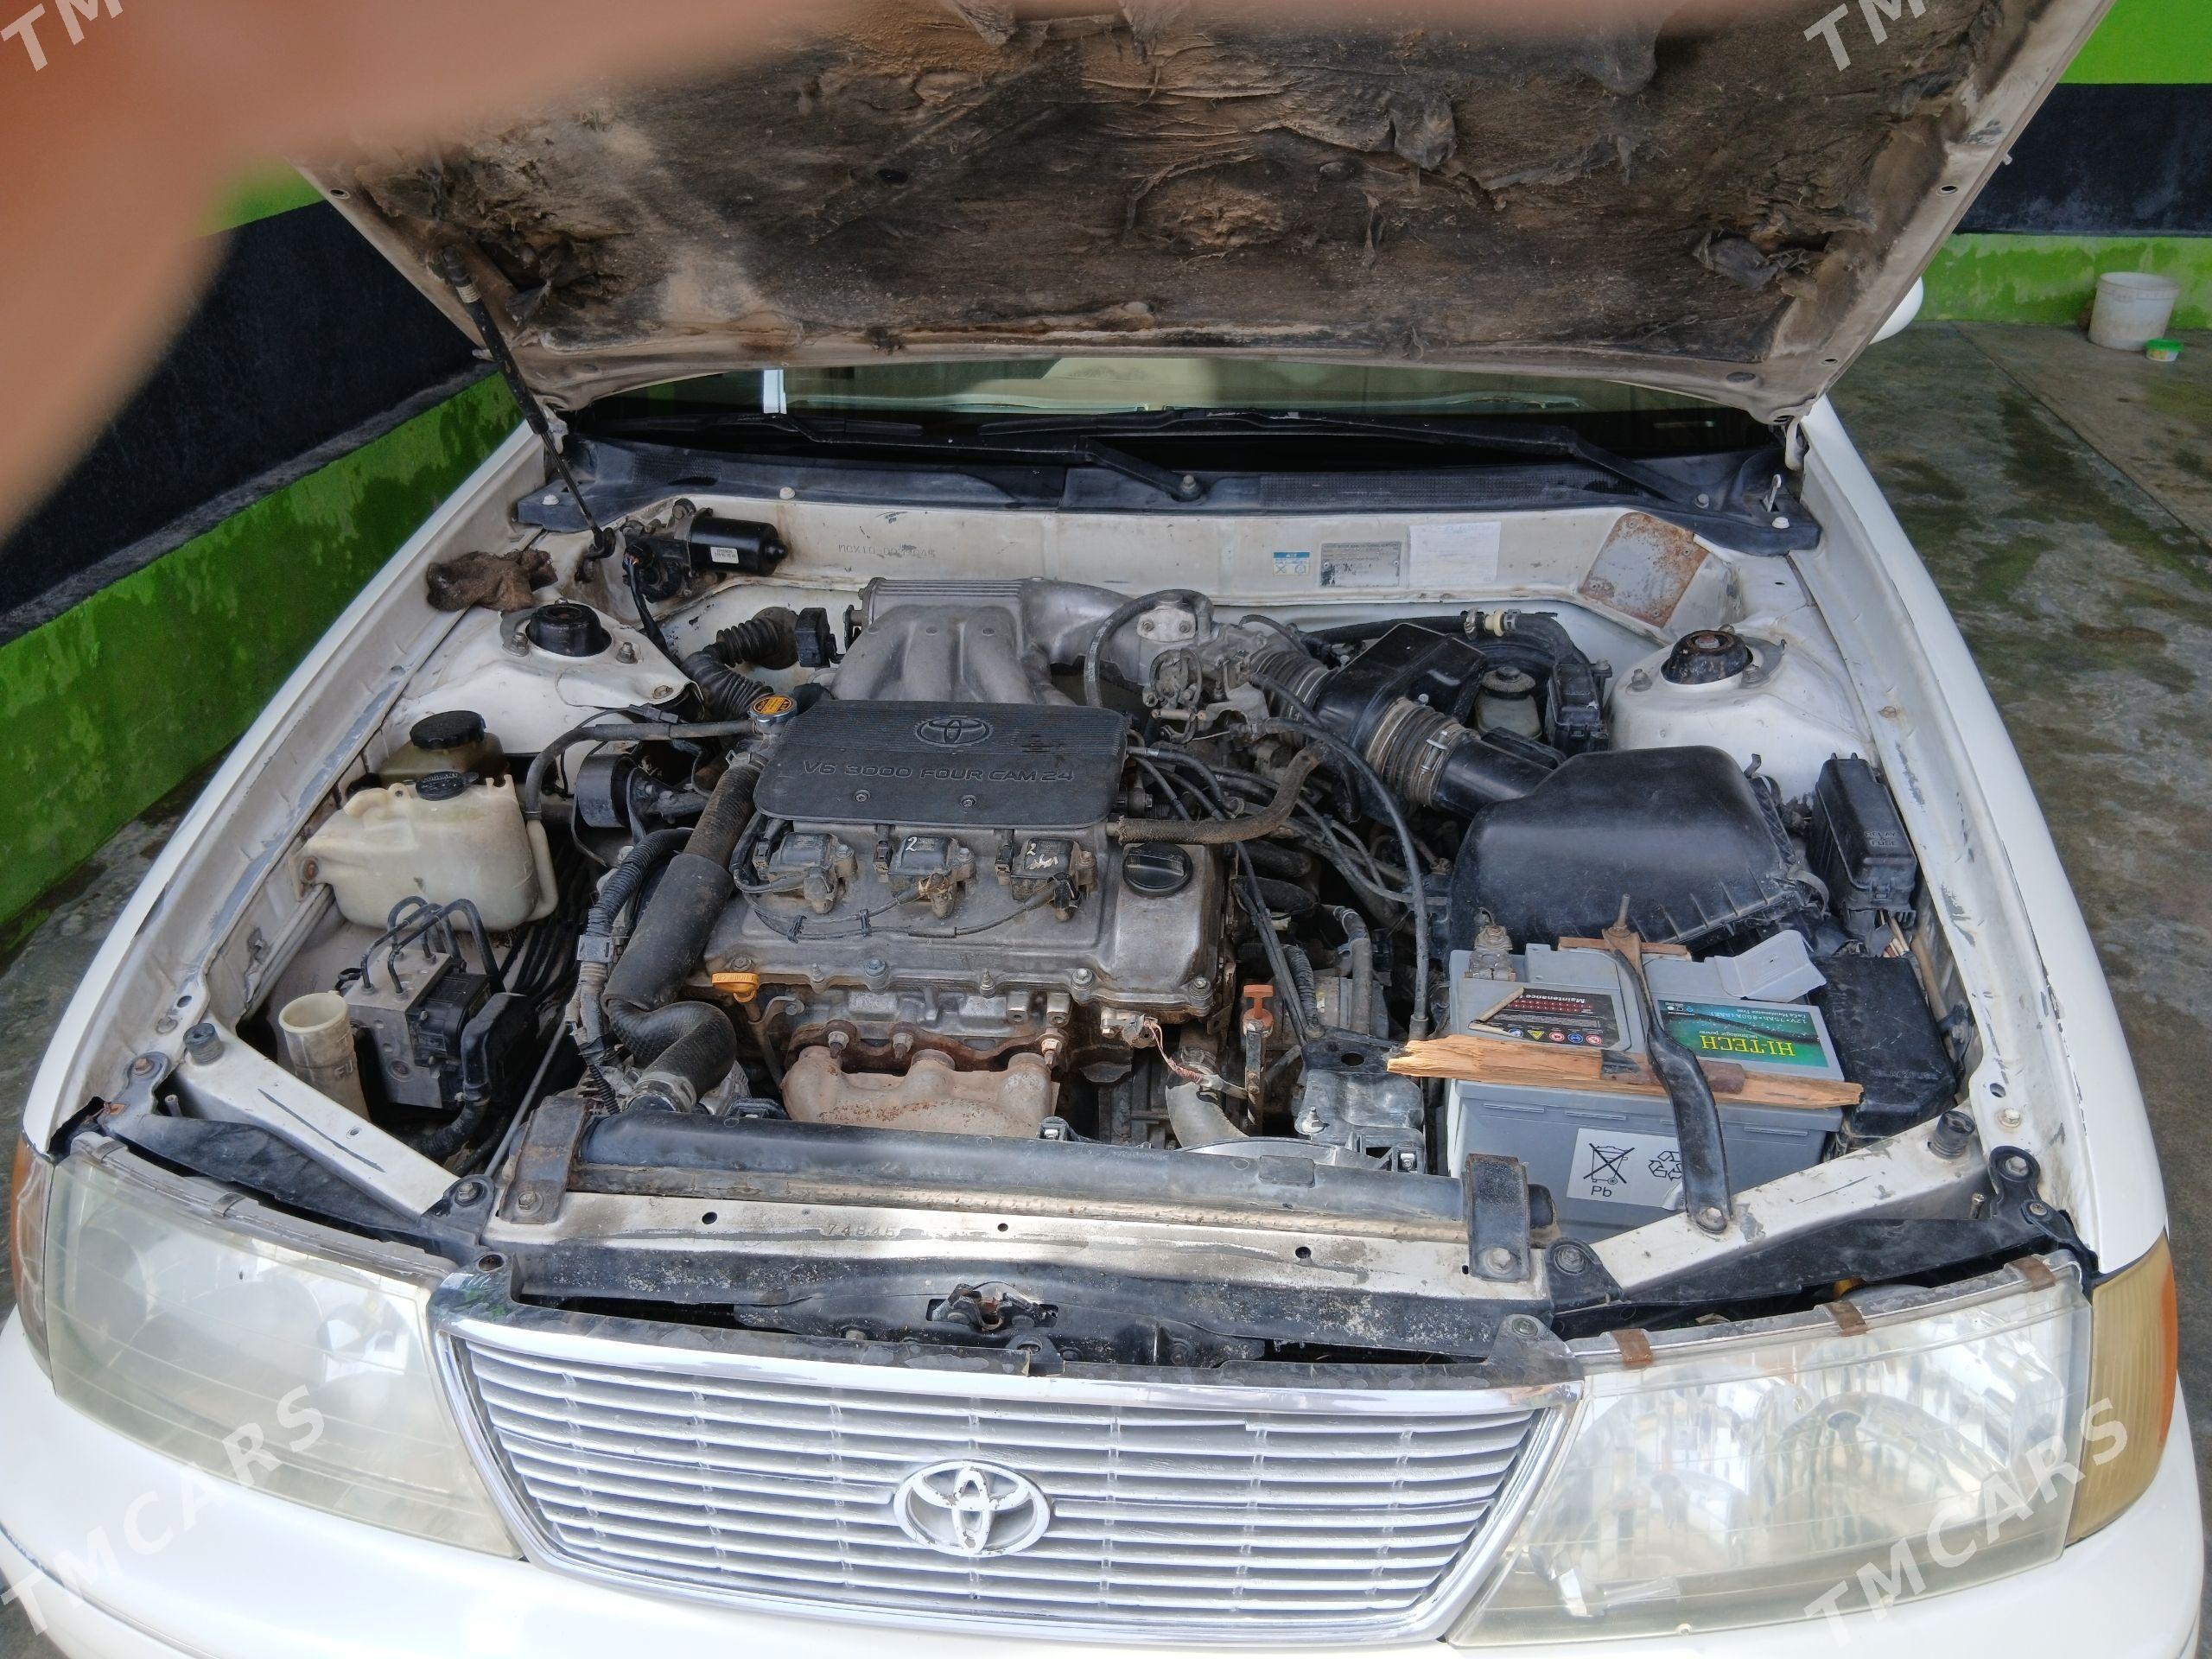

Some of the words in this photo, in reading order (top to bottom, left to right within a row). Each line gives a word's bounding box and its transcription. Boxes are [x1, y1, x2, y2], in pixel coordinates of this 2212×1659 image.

[804, 760, 836, 776] V6
[844, 765, 912, 779] 3000
[919, 767, 983, 781] FOUR
[988, 769, 1037, 782] CAM
[1040, 769, 1074, 782] 24
[906, 836, 918, 852] 2
[1526, 994, 1586, 1003] Maintenance
[1700, 1035, 1796, 1057] HI-TECH
[1591, 1185, 1612, 1198] Pb
